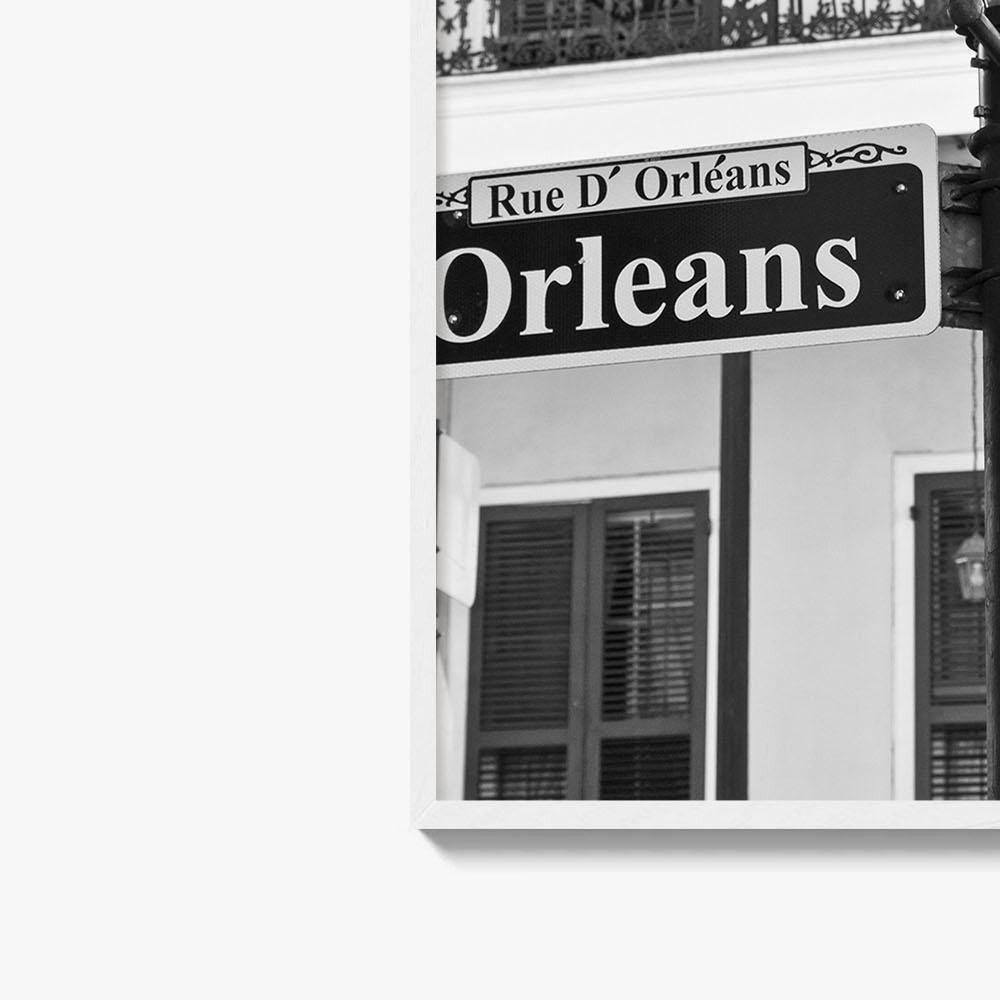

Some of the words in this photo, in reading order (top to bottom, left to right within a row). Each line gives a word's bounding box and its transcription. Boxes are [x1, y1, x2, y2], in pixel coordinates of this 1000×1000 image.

[487, 183, 565, 220] Rue
[634, 154, 791, 202] Orléans
[436, 234, 862, 344] Orleans
